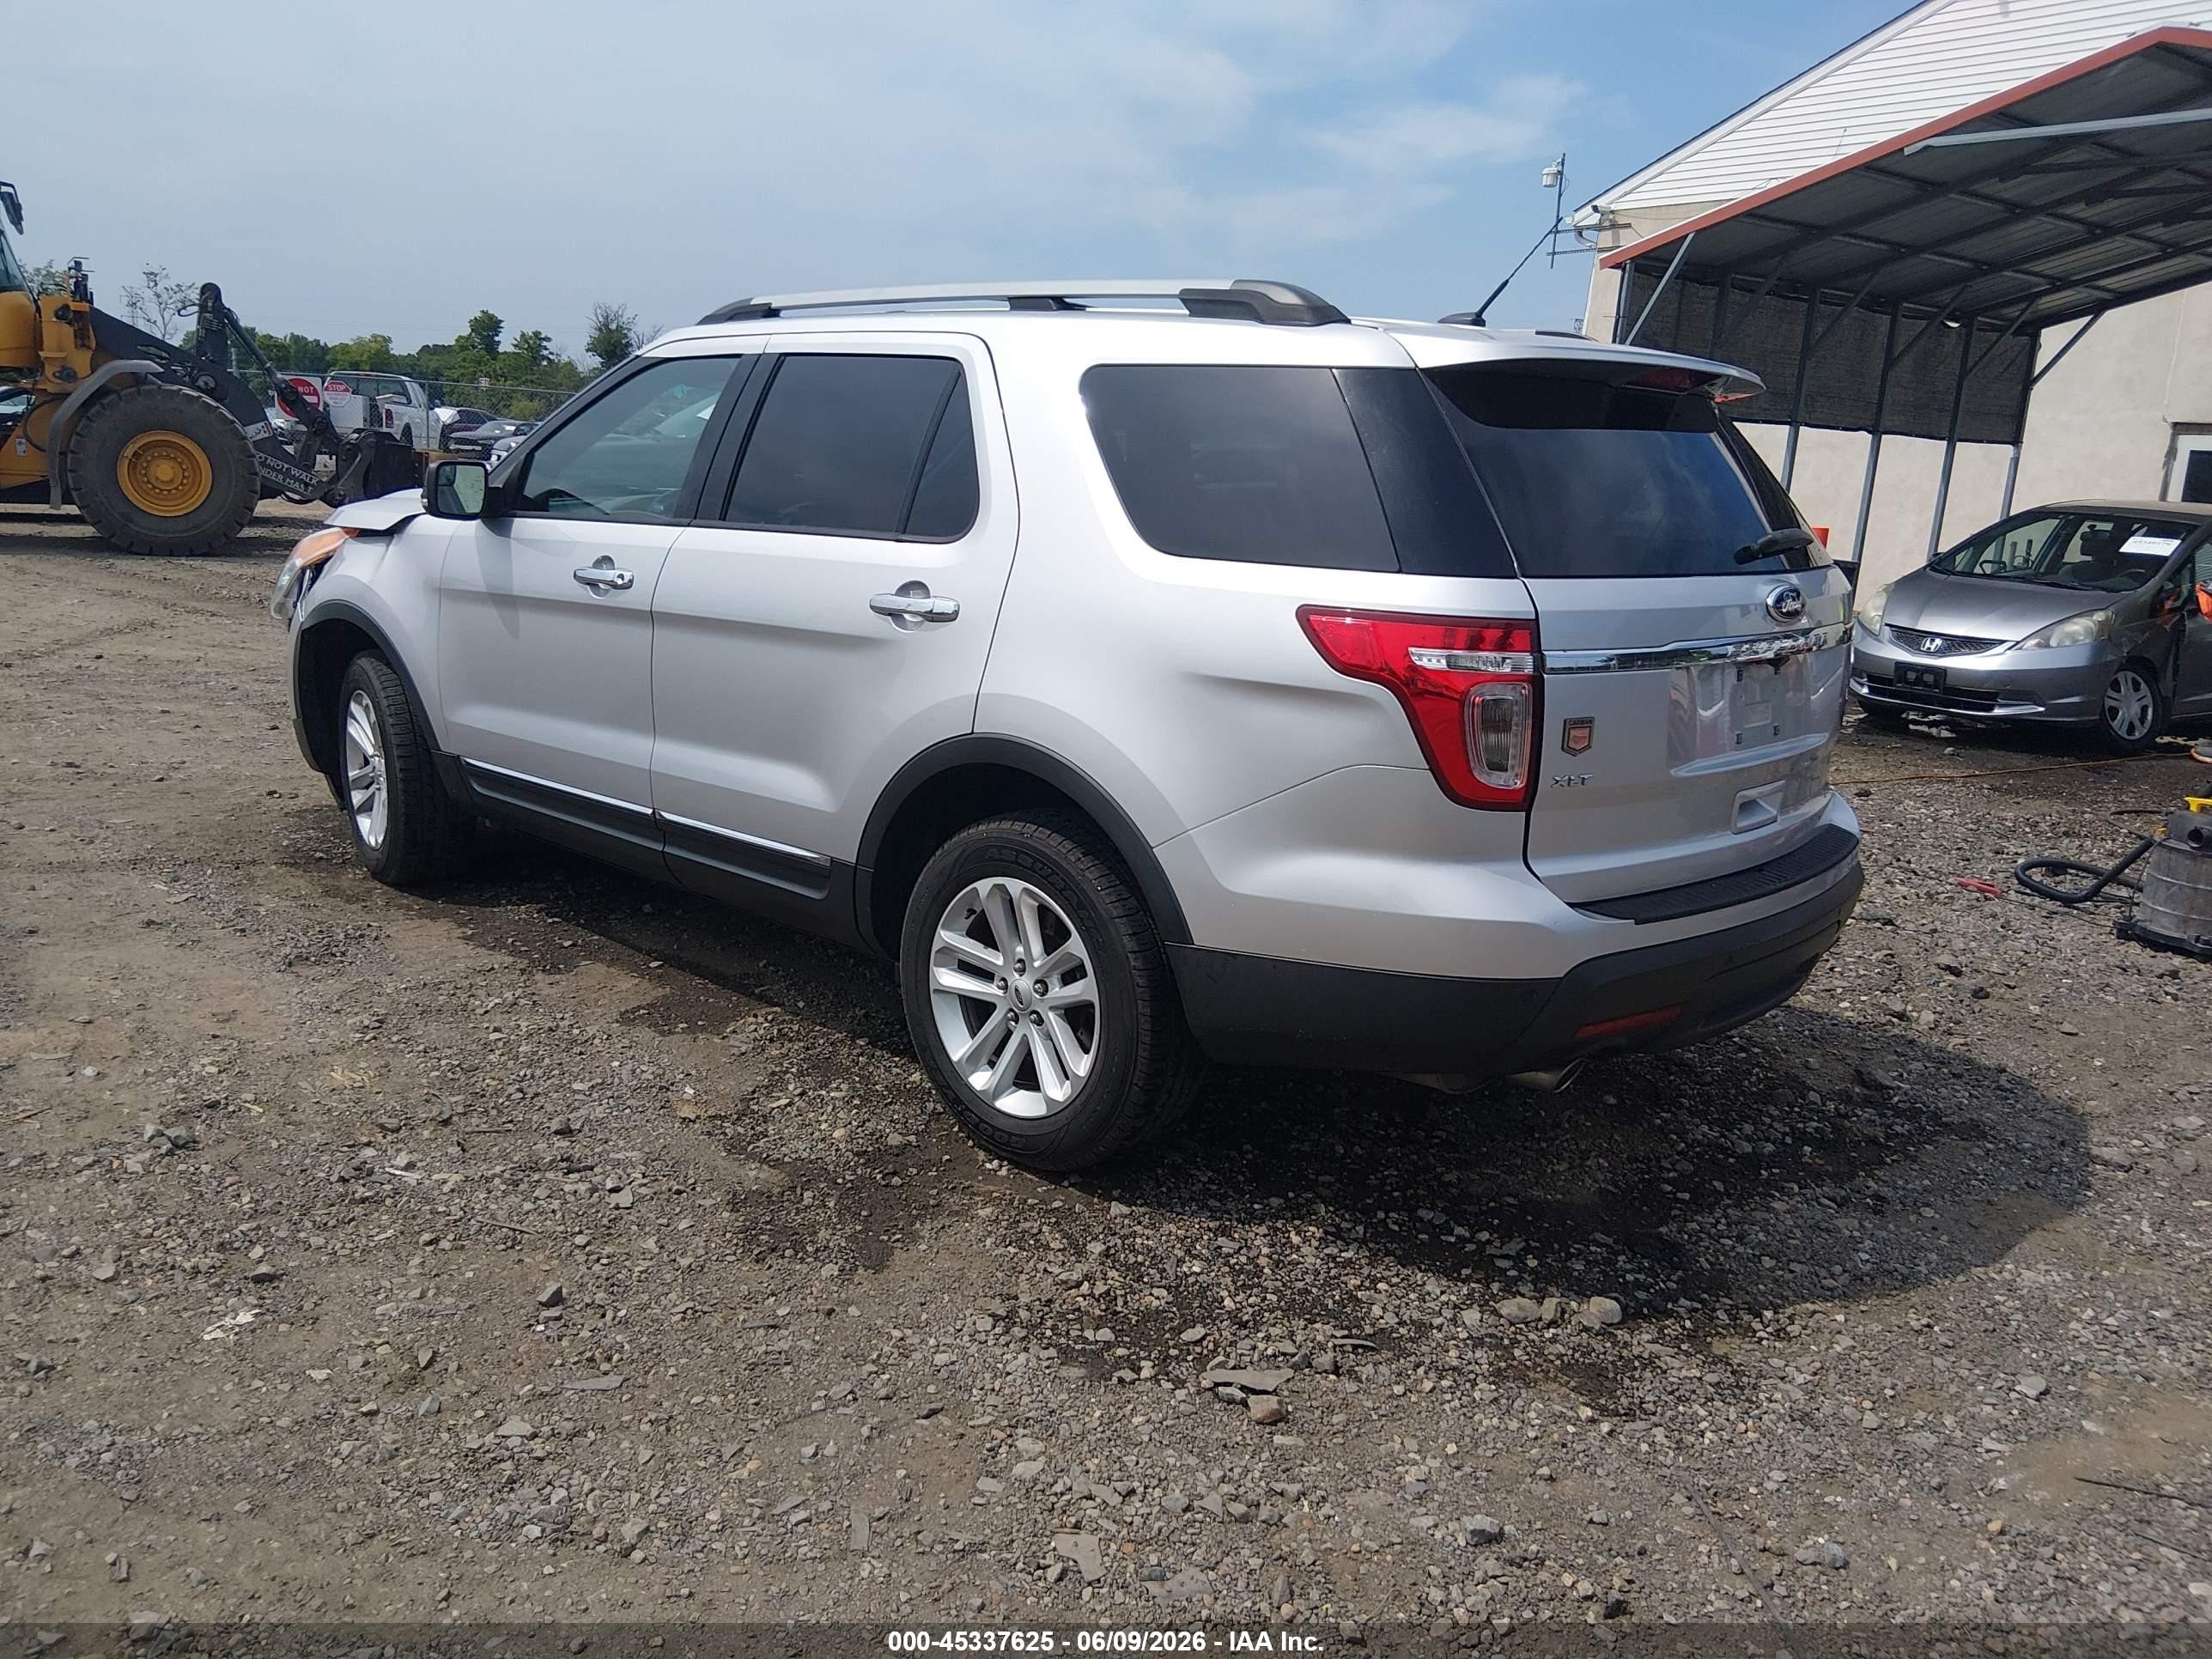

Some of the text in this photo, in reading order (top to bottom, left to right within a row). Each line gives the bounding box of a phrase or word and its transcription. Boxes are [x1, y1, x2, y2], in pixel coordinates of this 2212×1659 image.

[259, 465, 283, 482] NDER
[266, 459, 288, 471] NOT
[291, 468, 319, 486] WALK
[1551, 774, 1594, 787] XLT
